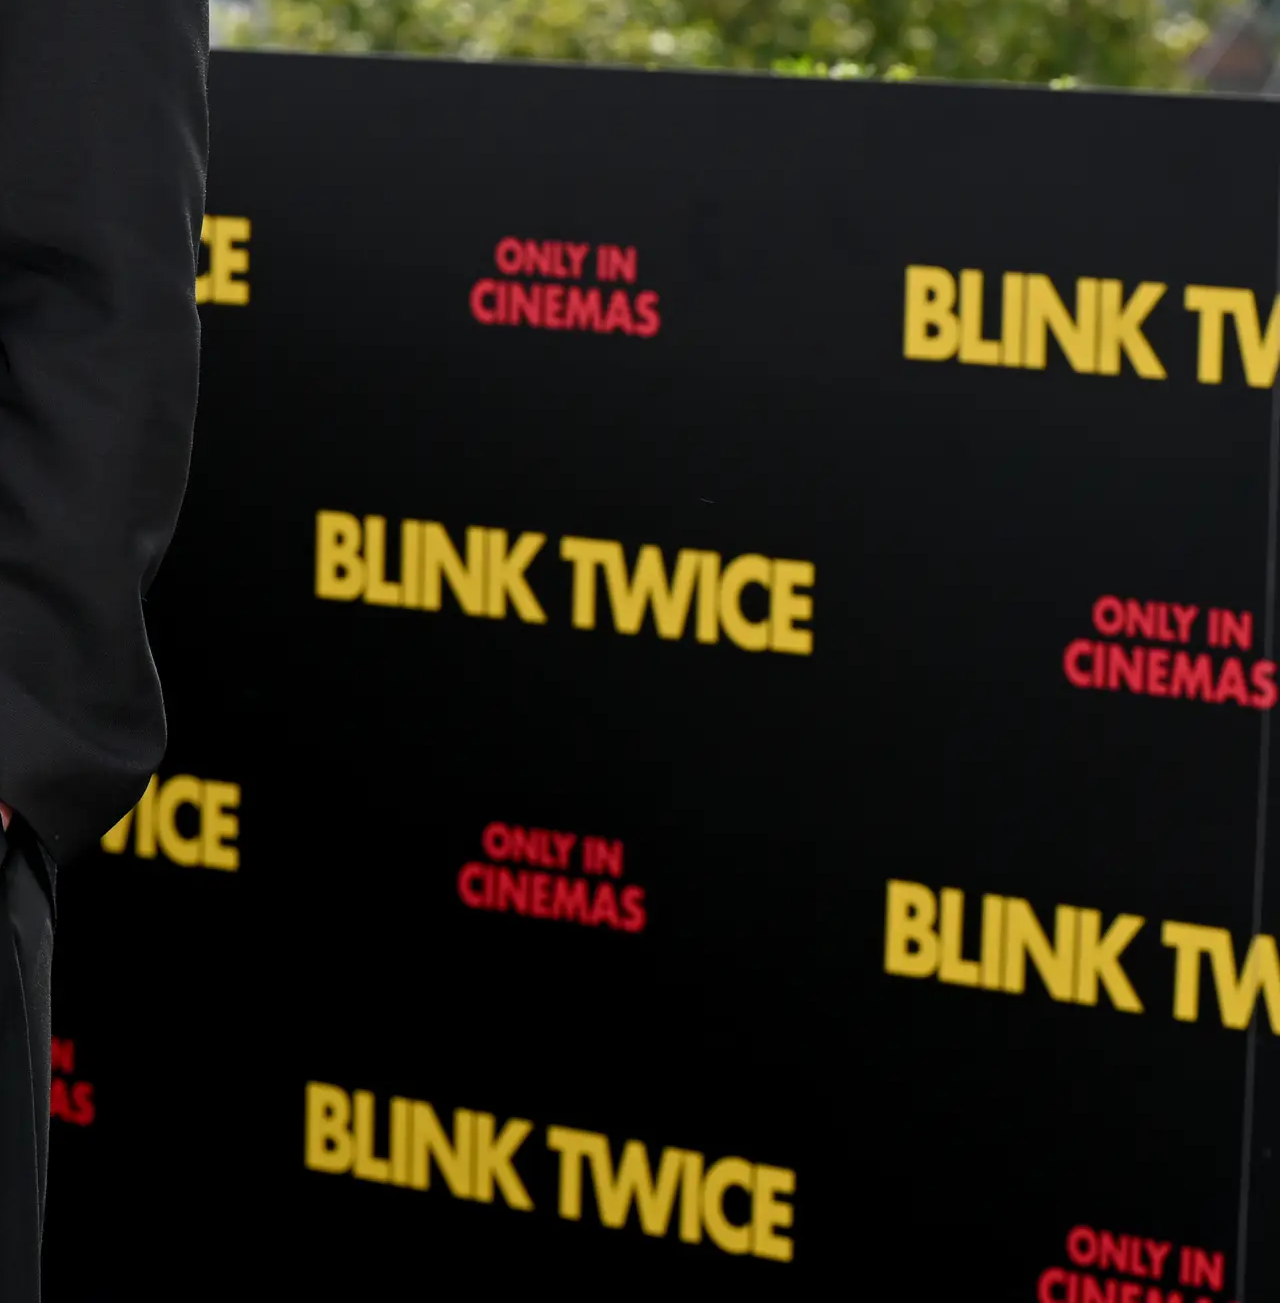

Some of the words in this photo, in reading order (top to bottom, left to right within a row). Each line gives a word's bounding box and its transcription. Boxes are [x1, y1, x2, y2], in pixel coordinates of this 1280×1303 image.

[495, 236, 590, 279] ONLY
[596, 244, 638, 284] IN
[469, 277, 662, 338] CINEMAS
[903, 264, 1168, 380] BLINK
[315, 510, 546, 624] BLINK
[560, 536, 815, 655] TWICE
[1092, 594, 1200, 644] ONLY
[1207, 607, 1253, 651] IN
[1063, 638, 1279, 710] CINEMAS
[483, 822, 577, 869] ONLY
[582, 835, 624, 877] IN
[458, 862, 646, 932] CINEMAS
[884, 879, 1145, 1013] BLINK
[305, 1082, 533, 1211] BLINK
[547, 1126, 796, 1262] TWICE
[1066, 1225, 1173, 1280] ONLY
[1179, 1246, 1226, 1292] IN
